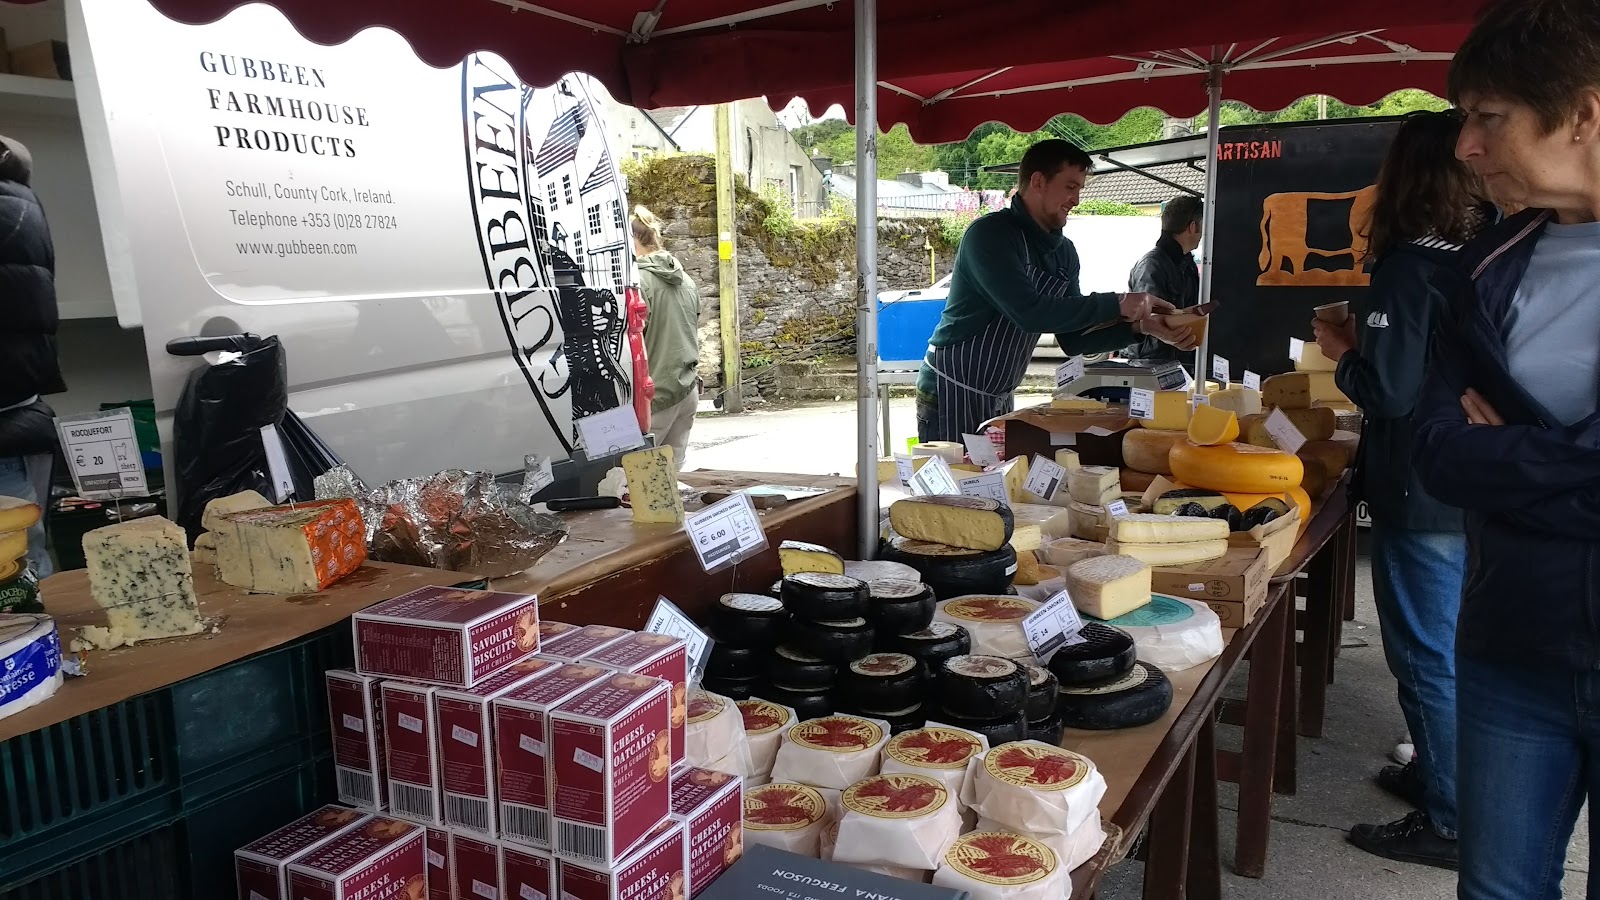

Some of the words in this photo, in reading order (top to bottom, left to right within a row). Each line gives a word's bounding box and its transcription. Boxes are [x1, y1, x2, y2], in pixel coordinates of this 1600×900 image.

[199, 50, 326, 89] GUBBEEN
[206, 87, 369, 127] FARMHOUSE
[214, 125, 356, 158] PRODUCTS
[1217, 140, 1282, 161] ARTISAN
[225, 180, 272, 200] Schull,
[273, 183, 318, 204] County
[320, 186, 352, 204] Cork,
[354, 188, 396, 205] Ireland.
[228, 209, 298, 230] Telephone
[300, 213, 331, 228] +353
[333, 213, 363, 231] (0)28
[364, 215, 398, 230] 27824
[473, 52, 573, 400] GUBBEEN
[235, 240, 358, 258] www.gubbeen.com
[71, 426, 112, 437] ROCQUEFORT
[76, 455, 86, 467] €
[93, 456, 104, 466] 20
[710, 529, 726, 541] 6.00
[473, 625, 515, 653] SAVOURY
[1041, 628, 1049, 637] 14
[474, 637, 517, 667] BISCUITS
[474, 666, 491, 676] WITH
[491, 652, 513, 668] CHEESE
[516, 676, 562, 699] SAVOURY
[527, 677, 576, 701] BISCUITS
[573, 686, 615, 713] SAVOURY
[586, 687, 630, 716] BISCUITS
[613, 714, 636, 733] GUBBEEN
[637, 692, 667, 716] FARMHOUSE
[613, 723, 645, 754] CHEESE
[614, 729, 656, 768] OATCAKES
[614, 762, 628, 778] WITH
[629, 746, 651, 767] GUBBEEN
[614, 769, 634, 789] CHEESE
[691, 806, 714, 829] GUBBEEN
[691, 817, 721, 847] CHEESE
[256, 823, 314, 853] SAVOURY
[268, 825, 327, 856] BISCUITS
[310, 835, 366, 868] SAVOURY
[691, 821, 731, 860] OATCAKES
[321, 837, 379, 871] BISCUITS
[344, 865, 379, 888] GUBBEEN
[381, 838, 422, 865] FARMHOUSE
[619, 859, 648, 882] GUBBEEN
[648, 833, 682, 861] FARMHOUSE
[691, 854, 705, 869] WITH
[706, 837, 727, 859] GUBBEEN
[620, 867, 658, 900] CHEESE
[691, 860, 711, 879] CHEESE
[772, 868, 848, 894] FERGUSON
[756, 883, 786, 894] FOODS
